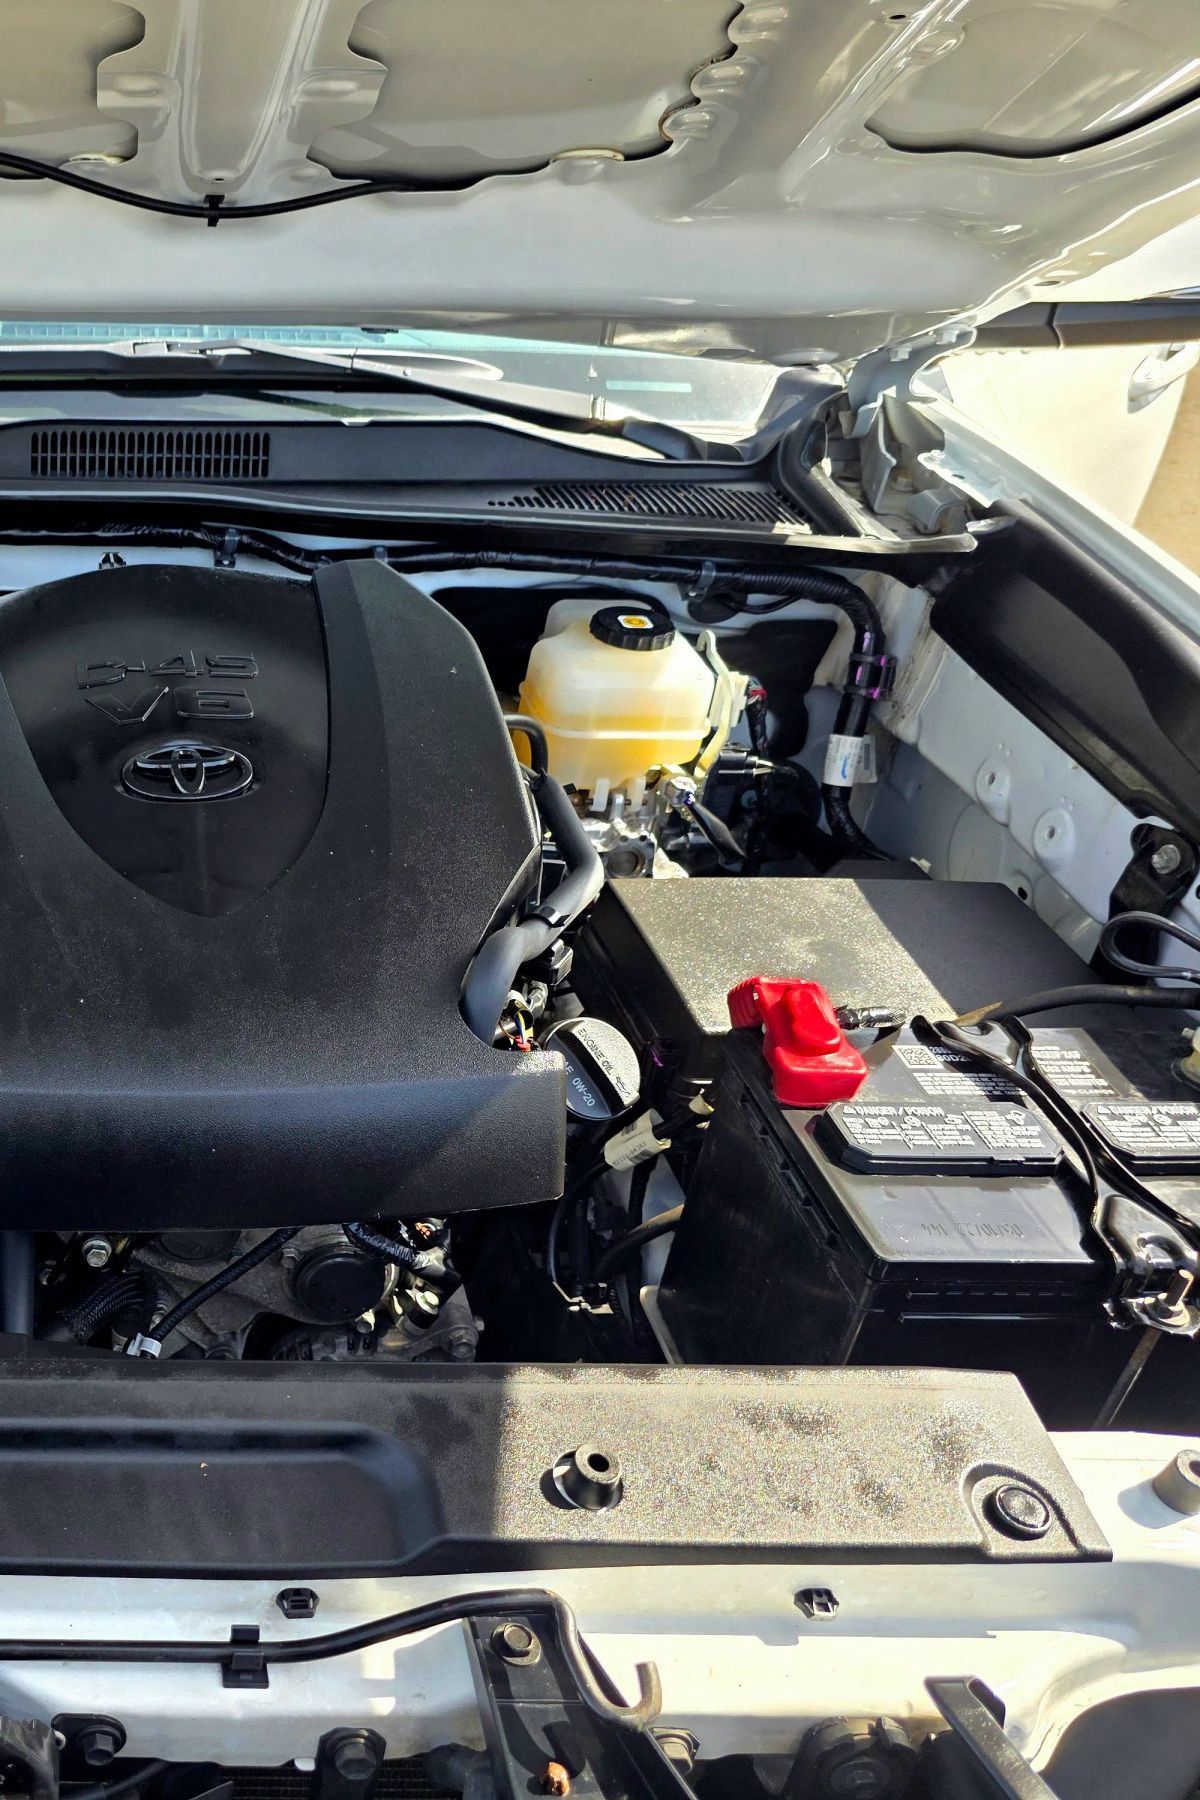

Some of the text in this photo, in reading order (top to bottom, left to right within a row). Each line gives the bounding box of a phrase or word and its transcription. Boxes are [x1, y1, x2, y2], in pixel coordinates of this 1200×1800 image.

[76, 650, 259, 689] D-4S
[85, 686, 255, 725] V6
[577, 1028, 614, 1076] ENGINE OIL
[572, 1077, 595, 1107] 0W-20
[854, 1105, 898, 1116] DANGER
[903, 1106, 945, 1117] POISON
[1108, 1105, 1151, 1115] DANGER
